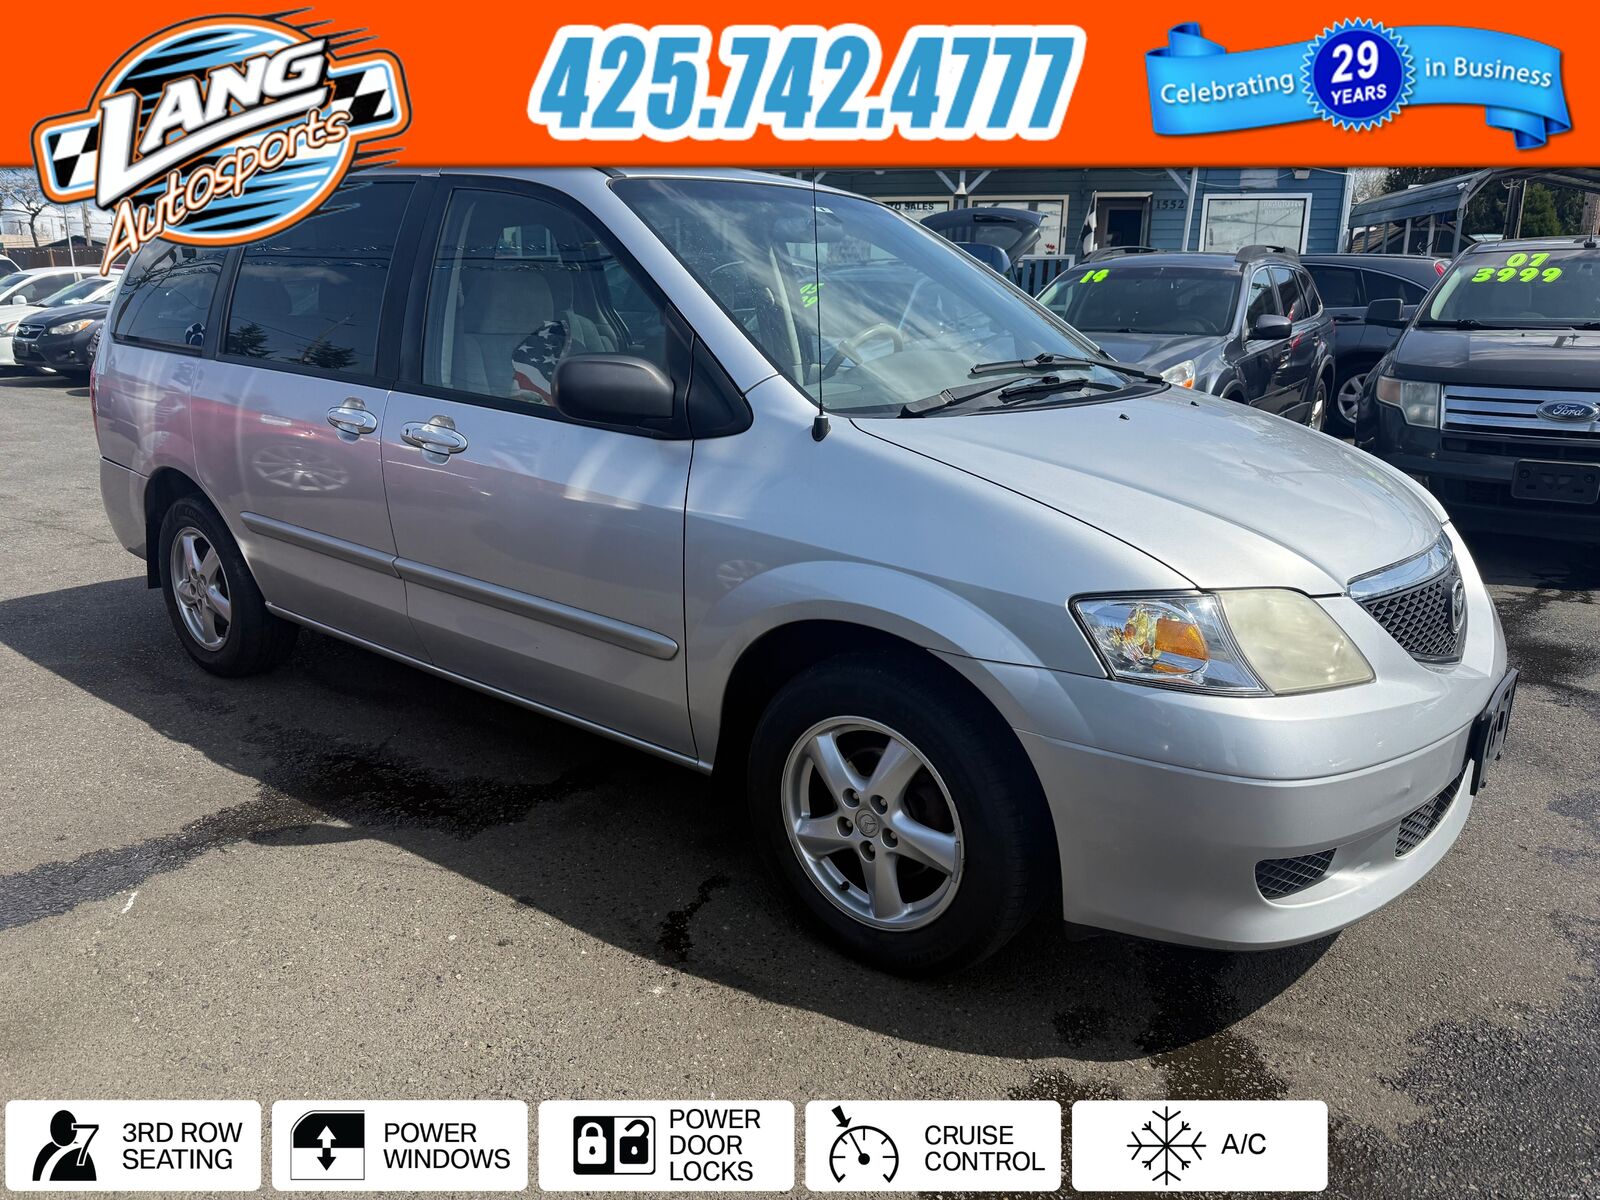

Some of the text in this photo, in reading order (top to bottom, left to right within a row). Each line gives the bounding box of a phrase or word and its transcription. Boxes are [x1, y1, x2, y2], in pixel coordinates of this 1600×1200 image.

[904, 202, 934, 211] SALES
[1156, 200, 1185, 209] 1552
[1506, 252, 1550, 267] 07
[1080, 269, 1109, 283] 14
[1472, 267, 1562, 283] 3999
[1552, 403, 1585, 416] Ford
